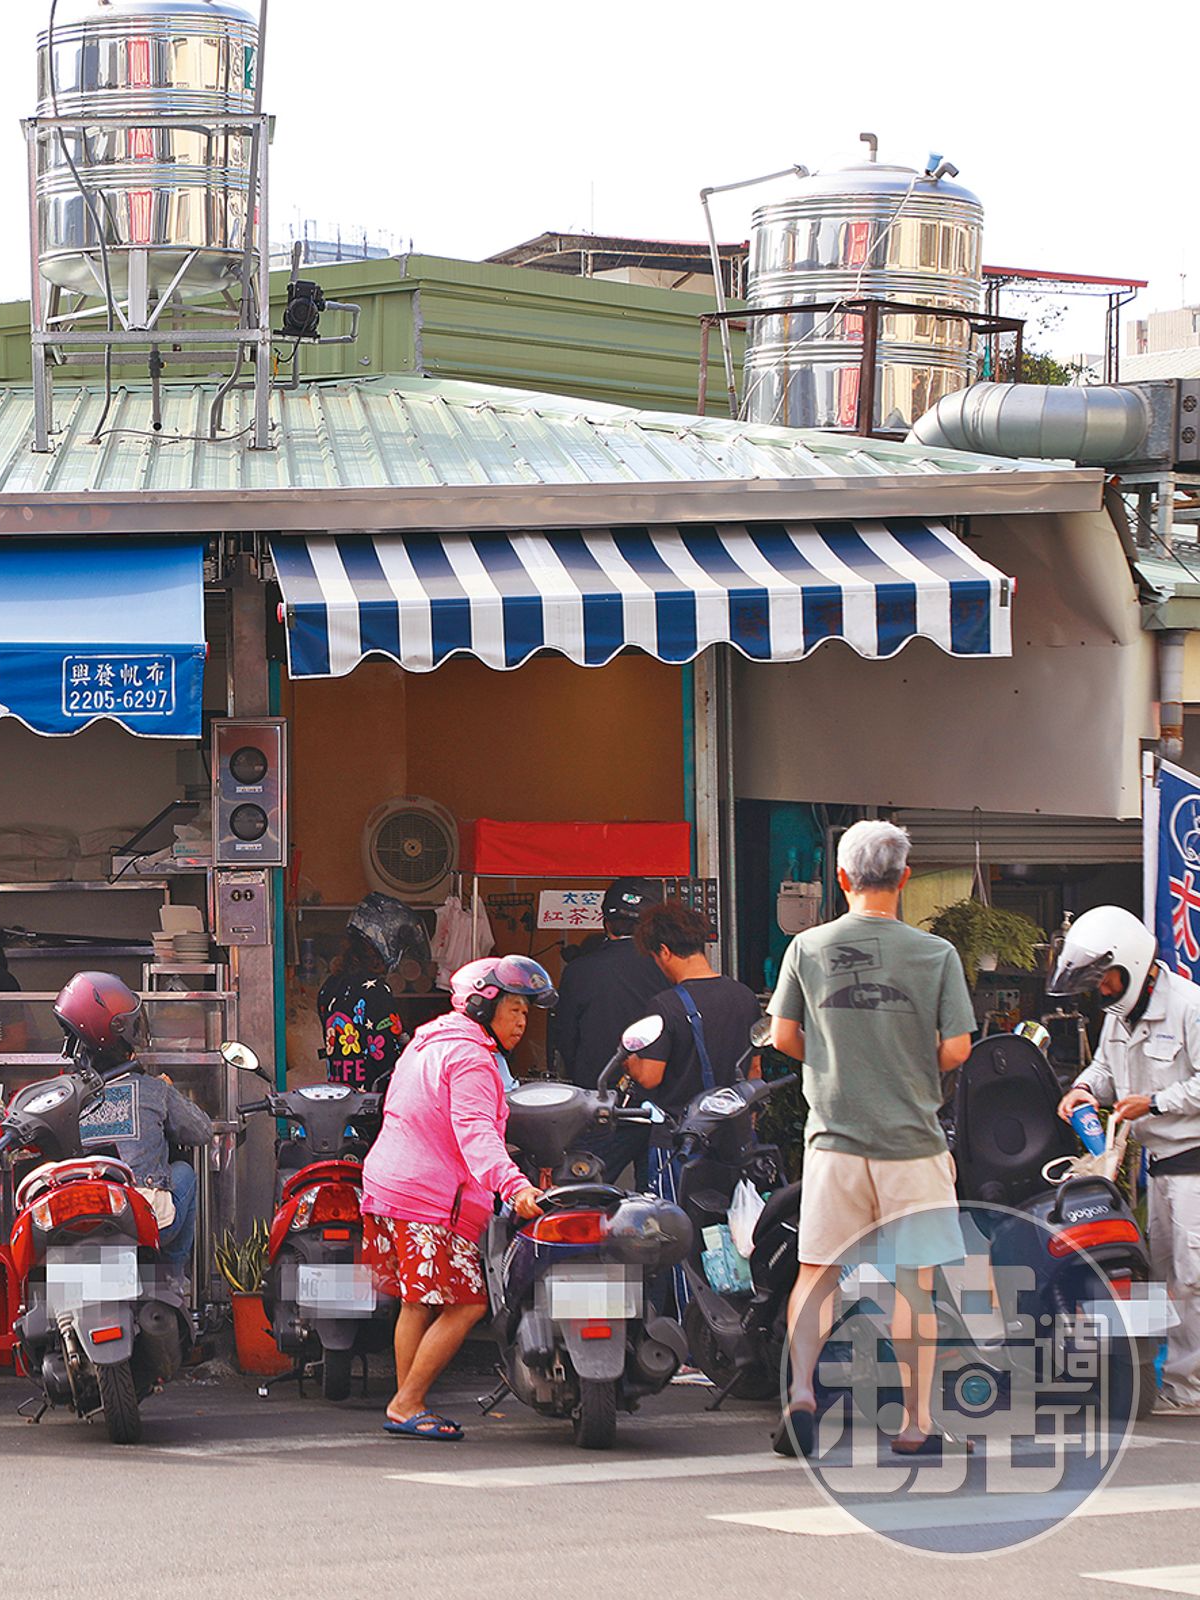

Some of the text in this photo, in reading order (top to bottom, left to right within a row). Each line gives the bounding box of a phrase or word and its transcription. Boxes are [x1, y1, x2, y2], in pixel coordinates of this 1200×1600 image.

[69, 662, 166, 687] 興發帆布
[69, 690, 168, 710] 2205-6297
[330, 1060, 366, 1081] IFE
